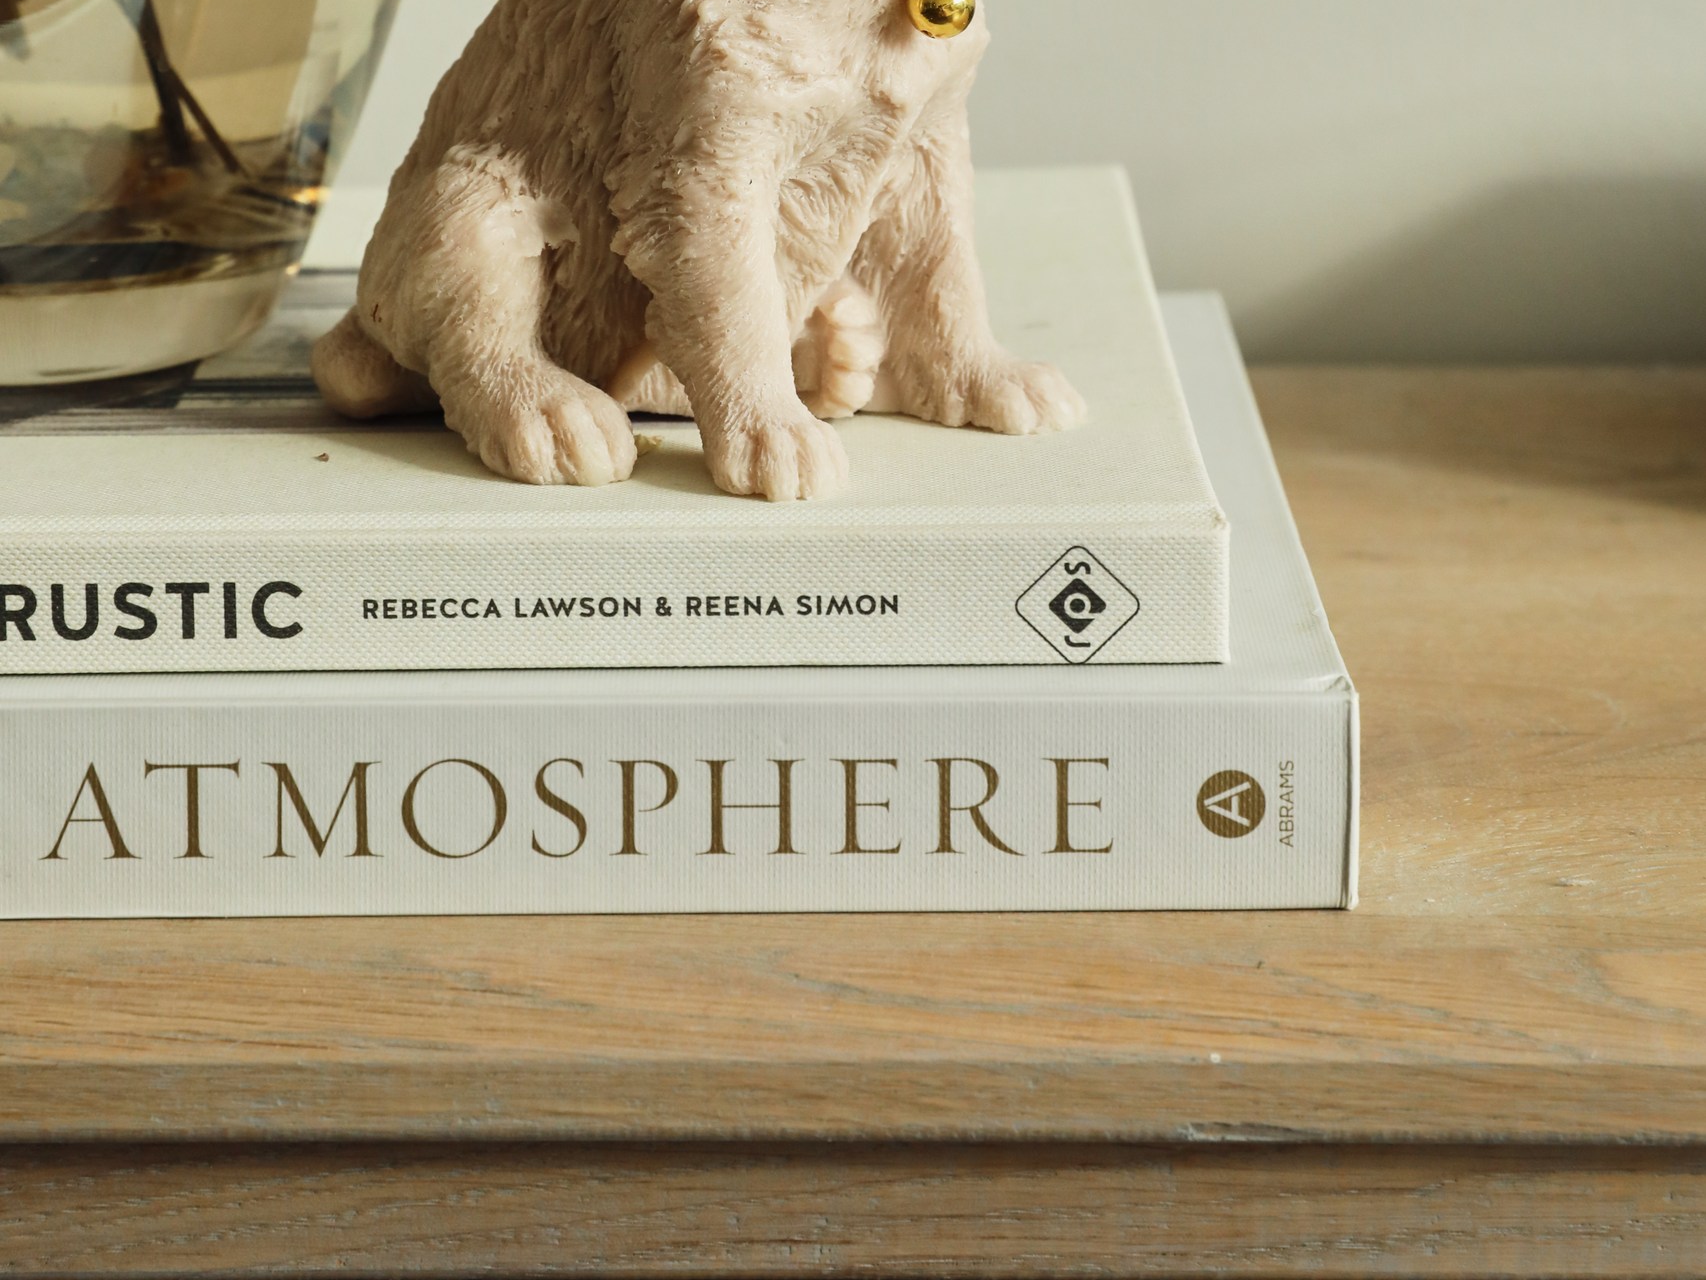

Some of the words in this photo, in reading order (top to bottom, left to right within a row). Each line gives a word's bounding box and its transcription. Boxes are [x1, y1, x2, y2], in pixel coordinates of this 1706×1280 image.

[0, 581, 305, 642] RUSTIC
[362, 597, 502, 620] REBECCA
[514, 596, 642, 619] LAWSON
[655, 596, 673, 618] &
[686, 595, 785, 617] REENA
[796, 594, 899, 616] SIMON
[38, 757, 1115, 861] ATMOSPHERE
[1278, 760, 1295, 848] ABRAMS
